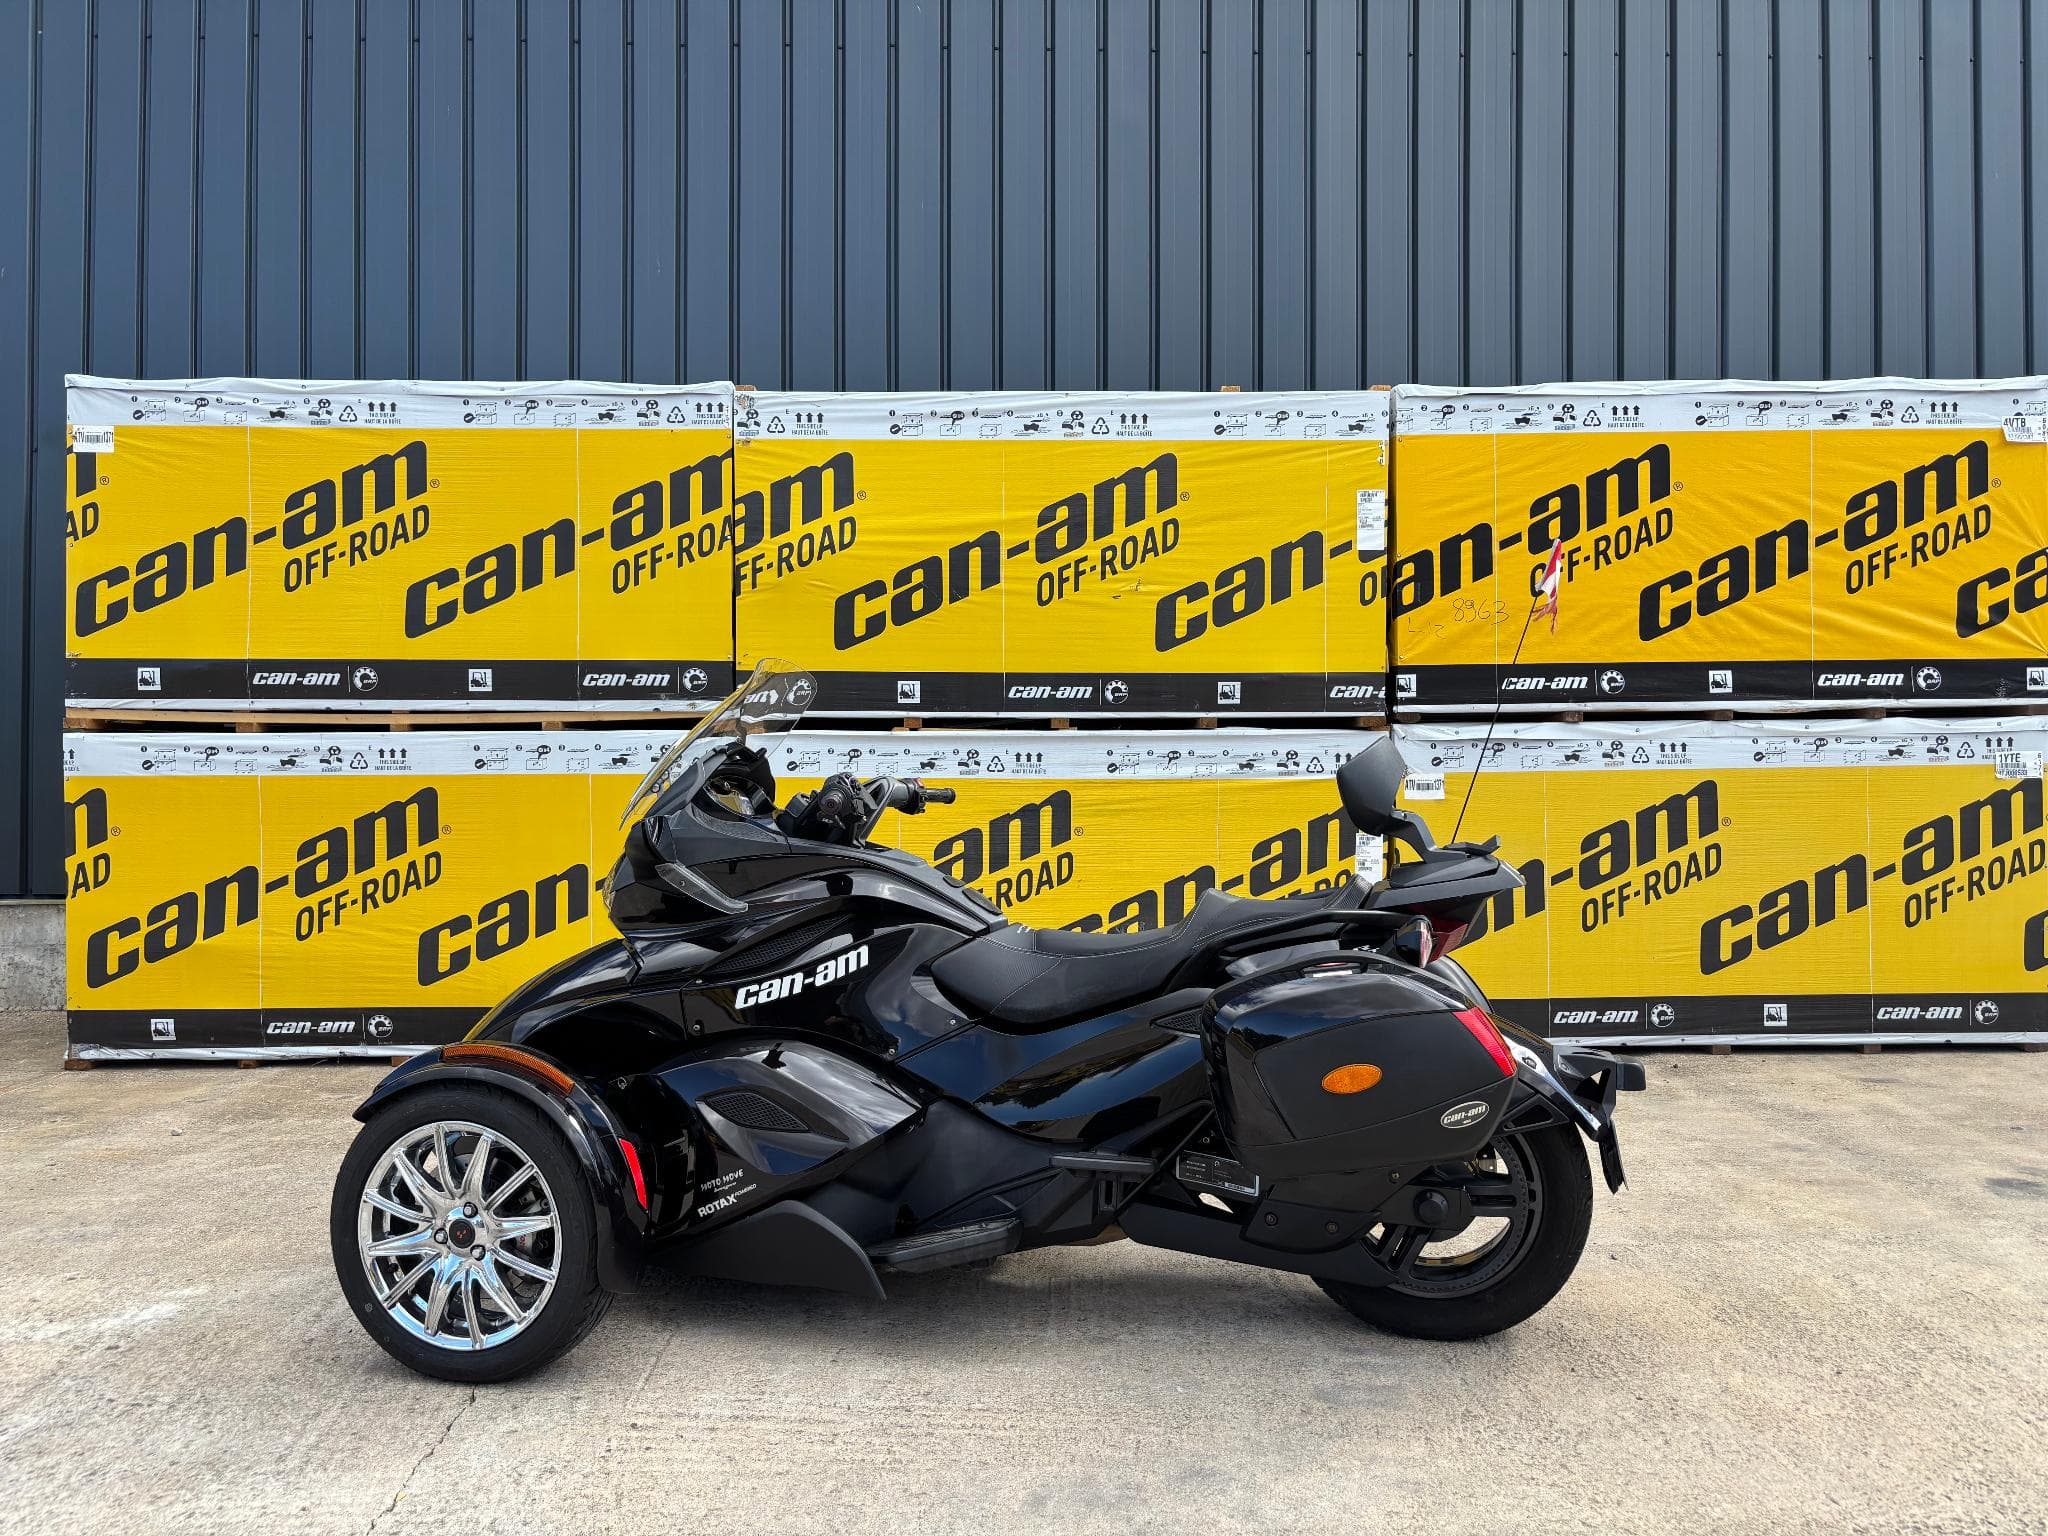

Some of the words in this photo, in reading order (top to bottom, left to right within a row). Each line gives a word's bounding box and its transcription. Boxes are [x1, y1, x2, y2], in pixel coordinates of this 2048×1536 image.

[76, 441, 427, 638] can-am
[285, 505, 429, 592] OFF-ROAD
[834, 453, 1177, 650] can-am
[1037, 518, 1179, 606] OFF-ROAD
[1531, 508, 1672, 598] OF-ROAD
[1639, 441, 1988, 641] can-am
[1846, 505, 1990, 594] OFF-ROAD
[1452, 598, 1509, 625] 8963
[253, 673, 340, 686] can-am
[583, 674, 670, 686] can-am
[1008, 686, 1092, 699] can-am
[1502, 677, 1588, 689] can-am
[1818, 673, 1904, 686] can-am
[1998, 752, 2021, 763] 1YTE
[87, 787, 438, 988] can-am
[296, 852, 441, 941] OFF-ROAD
[1582, 843, 1721, 932] OFF-ROAD
[1701, 778, 2043, 975] can-am
[1905, 839, 2045, 927] OFF-ROAD
[735, 945, 868, 1009] can-am
[267, 1021, 355, 1033] can-am
[1554, 1010, 1638, 1023] can-am
[1877, 1007, 1962, 1019] can-am
[1444, 1105, 1486, 1124] can-am
[701, 1178, 721, 1191] MOTO
[723, 1169, 744, 1183] MOVE
[698, 1193, 737, 1217] ROTAX
